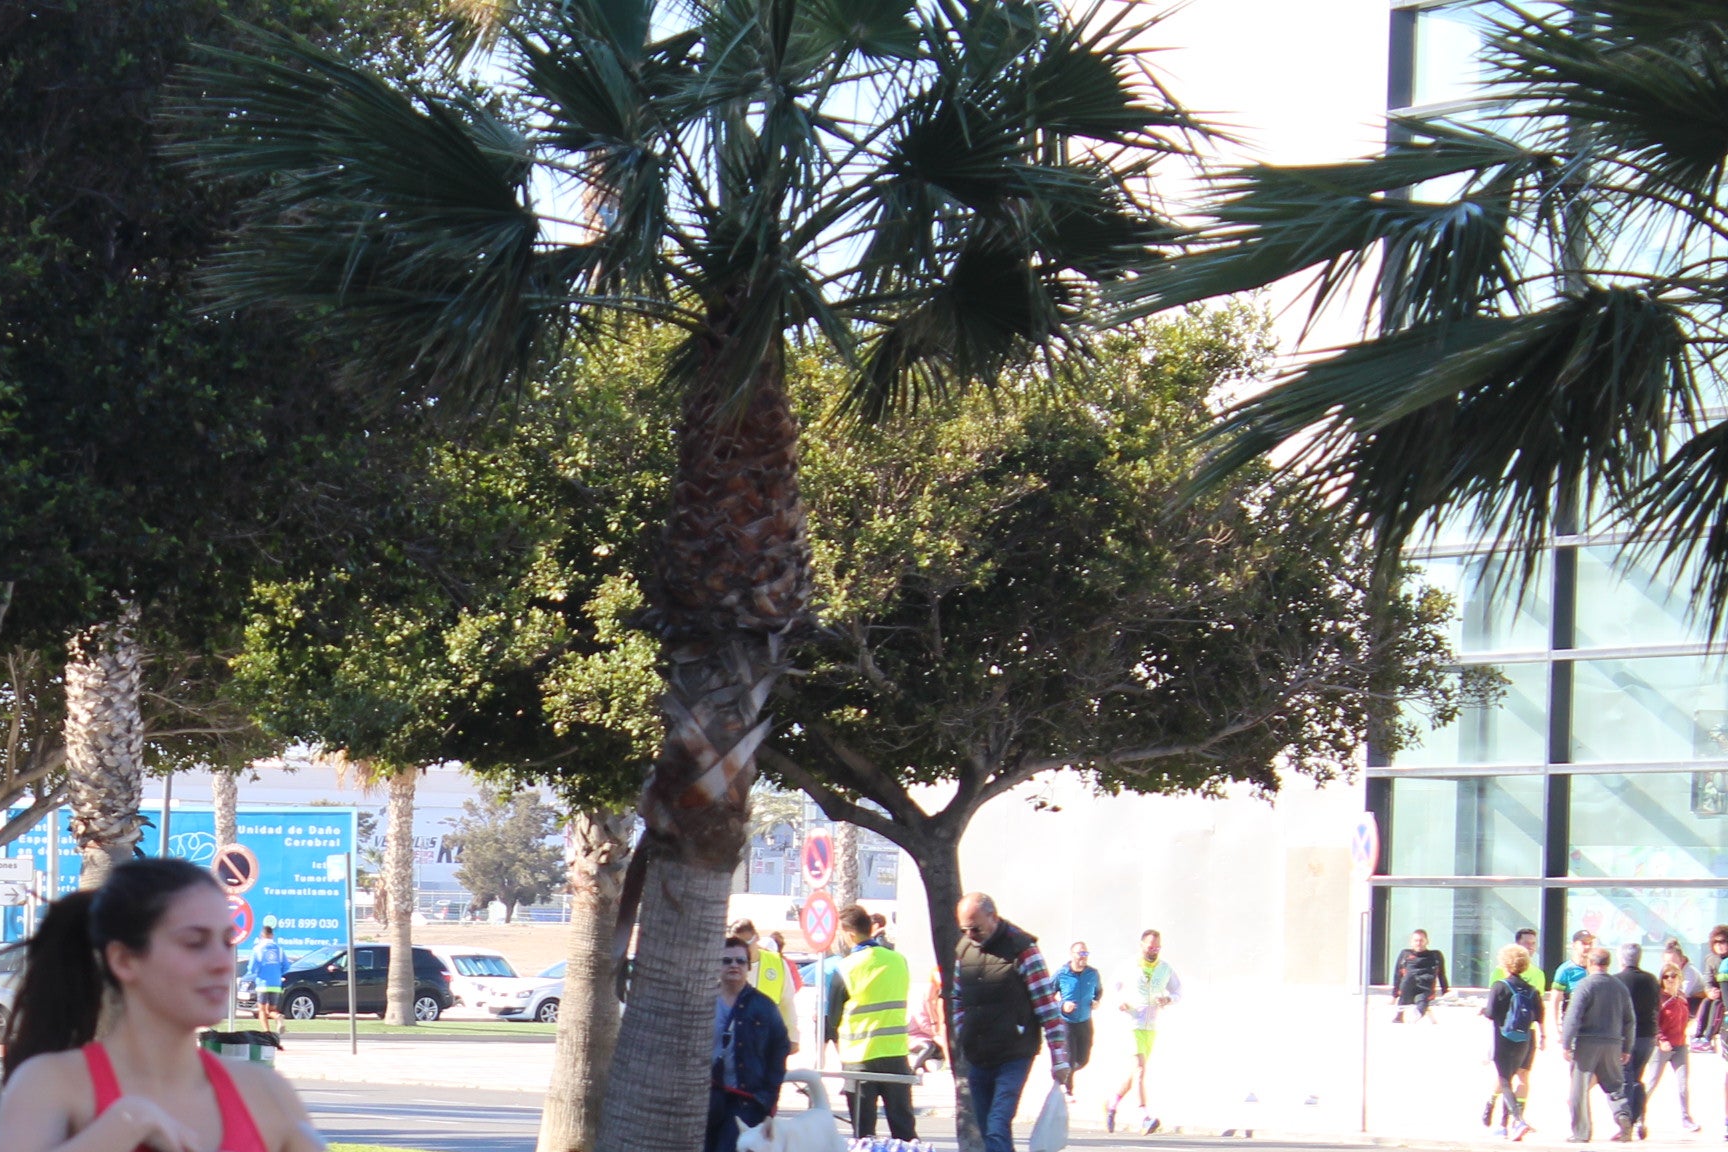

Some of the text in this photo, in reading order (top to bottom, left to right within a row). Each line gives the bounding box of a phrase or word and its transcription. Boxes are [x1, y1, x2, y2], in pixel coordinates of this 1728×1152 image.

[237, 825, 341, 835] Unidad de Daño
[284, 837, 341, 847] Cerebral
[264, 886, 340, 896] Traumatismos
[278, 919, 339, 929] 691 899 030
